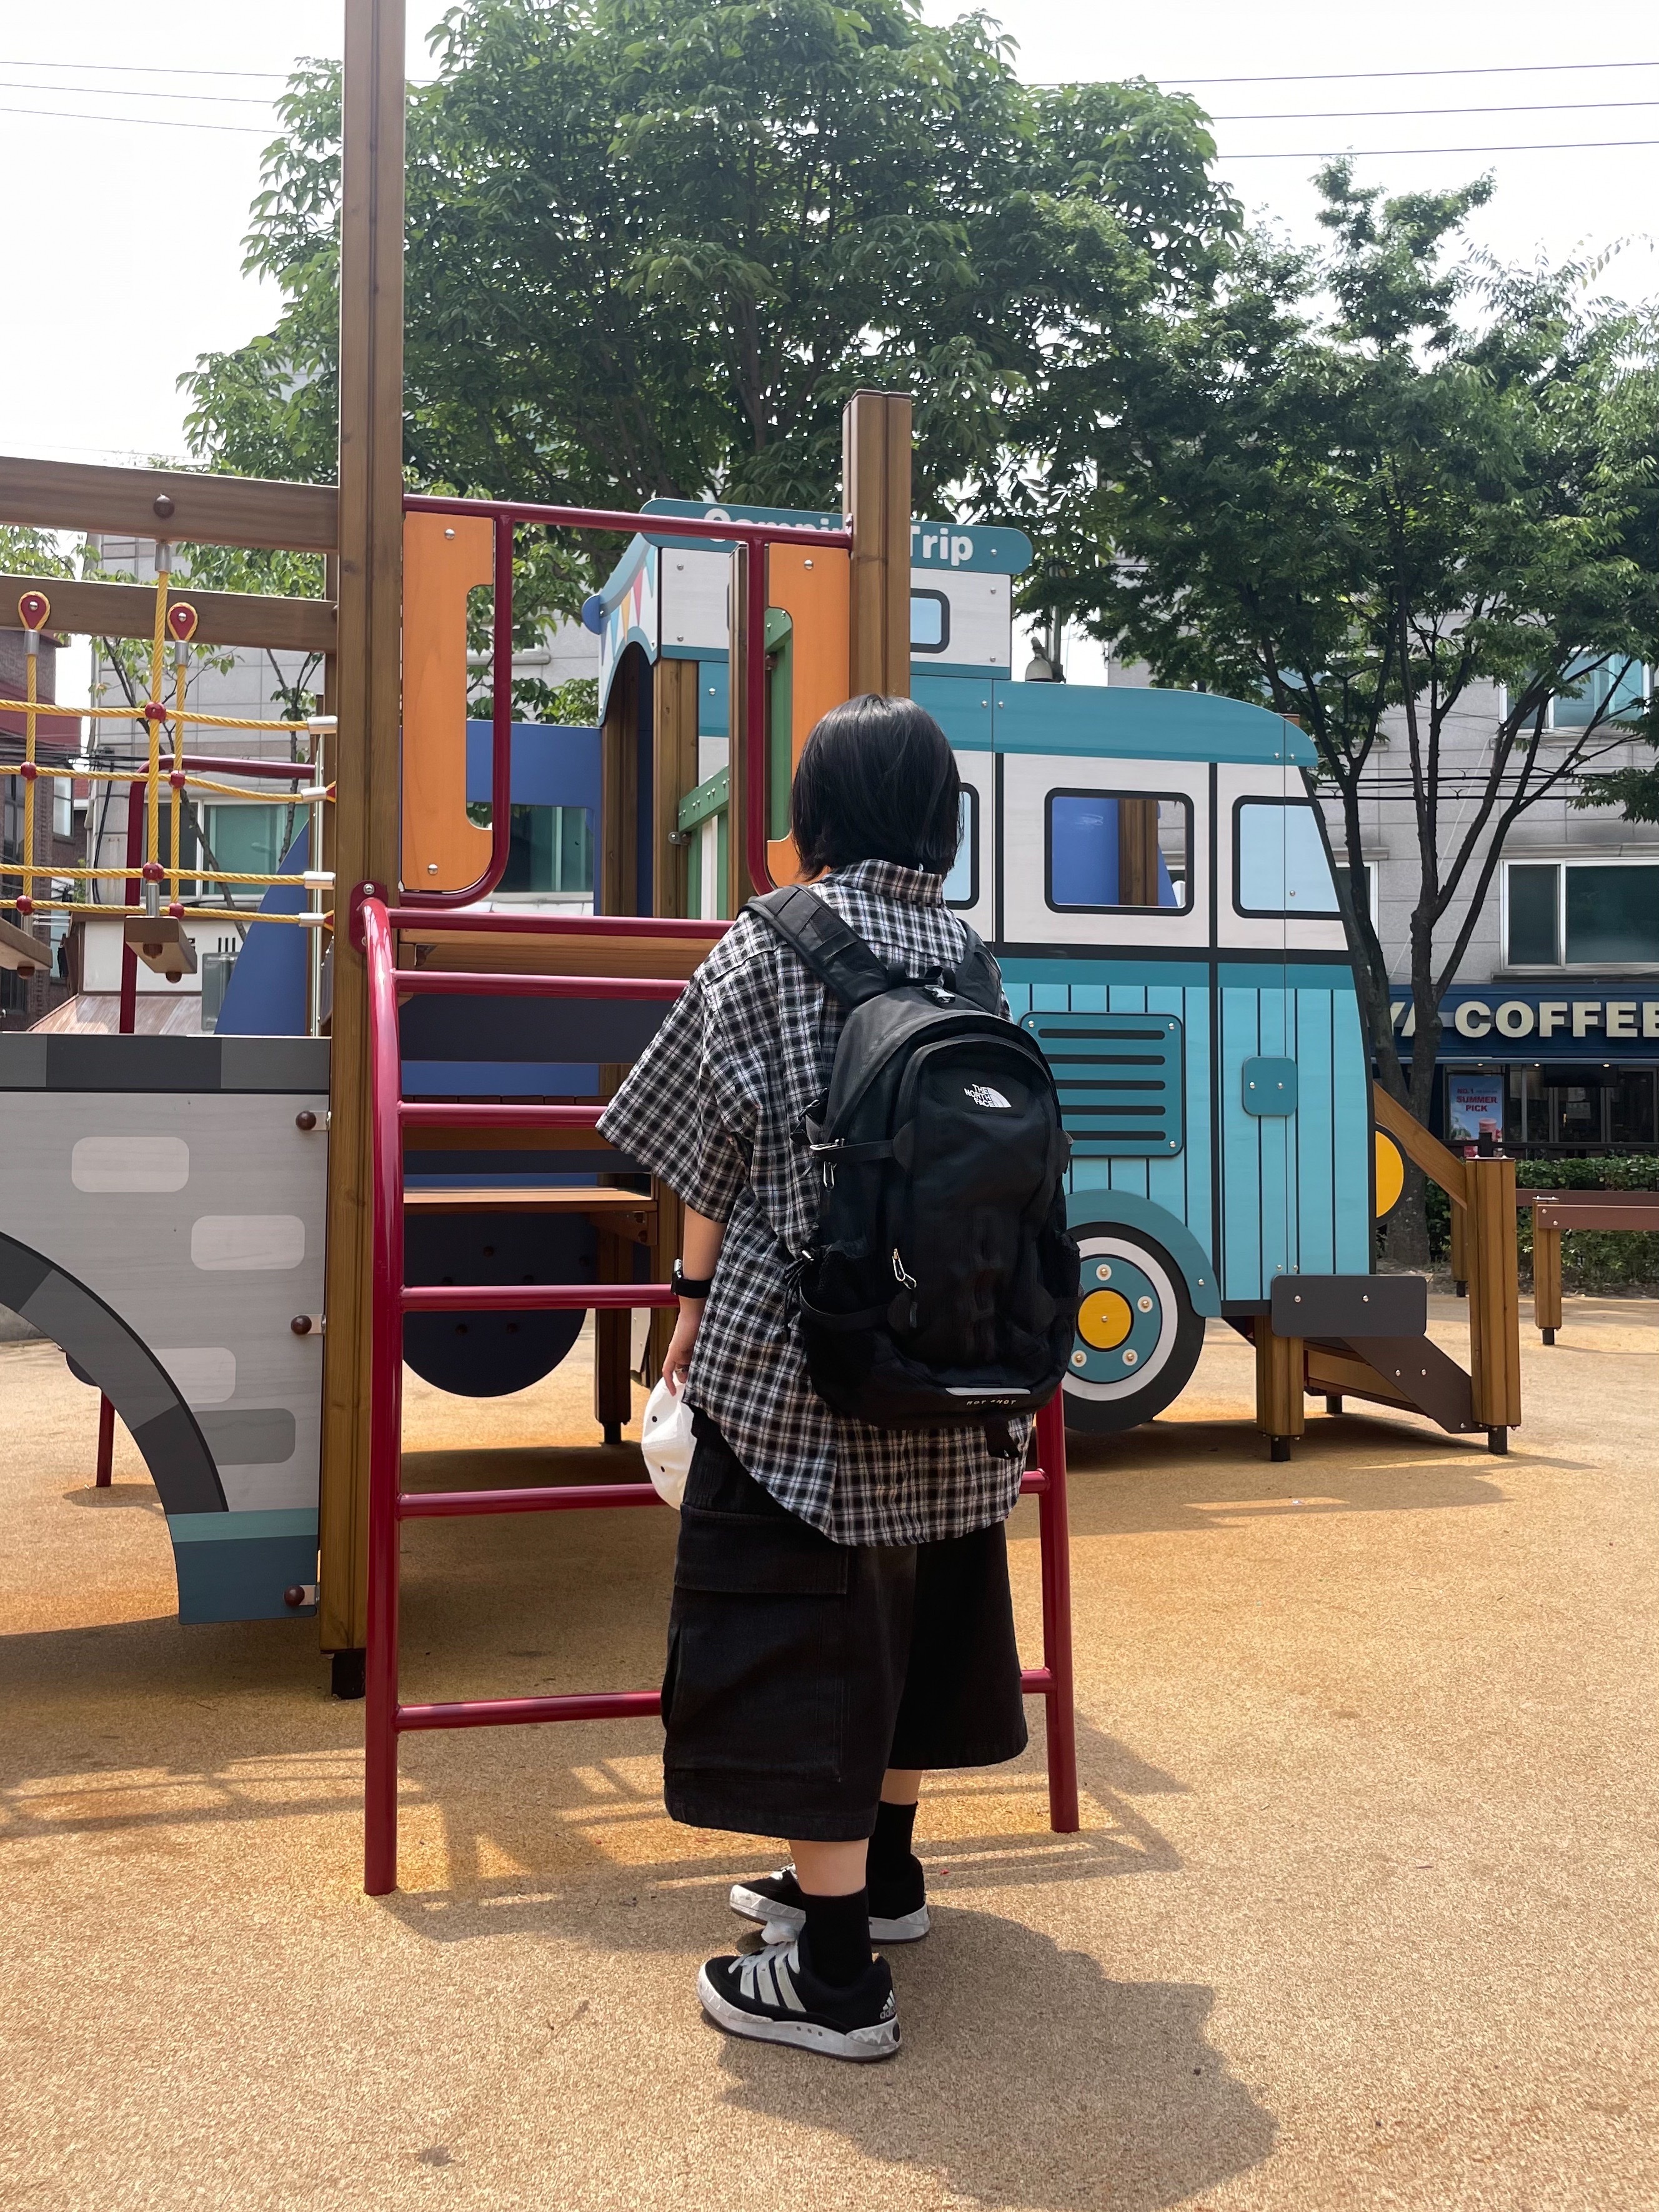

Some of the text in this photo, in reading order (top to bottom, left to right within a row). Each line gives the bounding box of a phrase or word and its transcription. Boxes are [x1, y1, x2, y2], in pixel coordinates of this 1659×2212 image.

[1455, 1000, 1659, 1038] COFFEE
[972, 1084, 989, 1094] THE
[964, 1088, 992, 1101] NORTH
[1457, 1095, 1497, 1104] SUMMER
[974, 1097, 995, 1107] FACE
